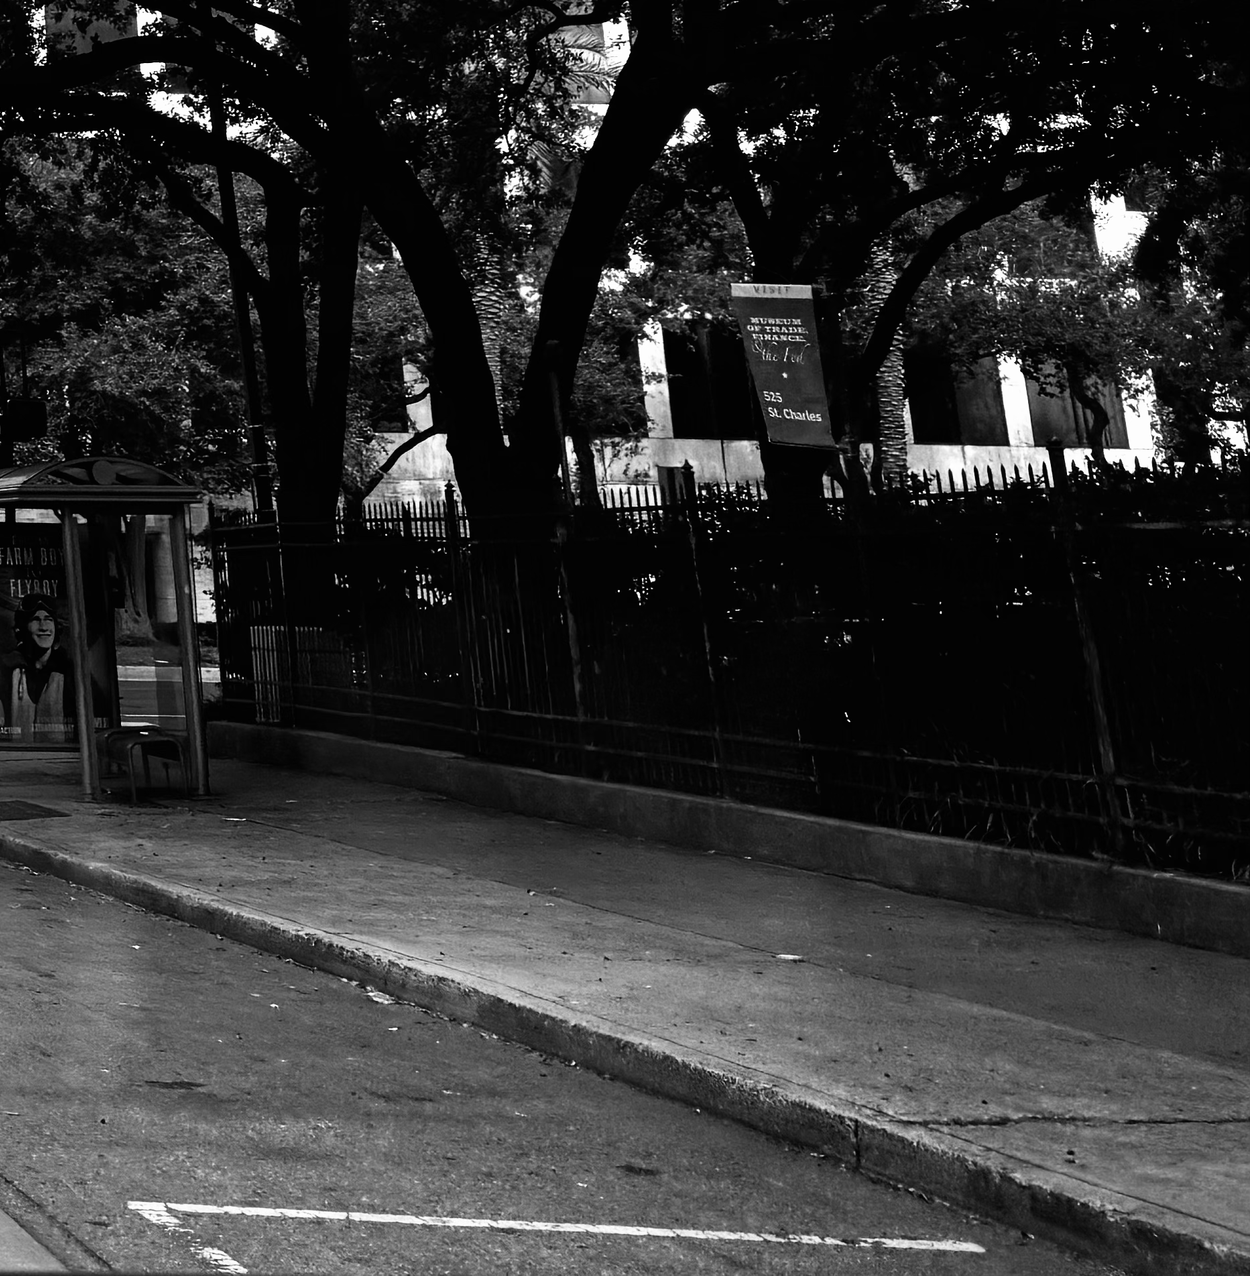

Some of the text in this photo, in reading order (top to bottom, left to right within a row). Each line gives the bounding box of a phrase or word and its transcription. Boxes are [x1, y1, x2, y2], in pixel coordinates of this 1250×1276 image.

[752, 285, 790, 295] VISIT
[749, 317, 802, 325] MUSEUM
[762, 390, 783, 403] 525
[783, 408, 822, 422] Charles
[9, 578, 59, 598] FLYBOY
